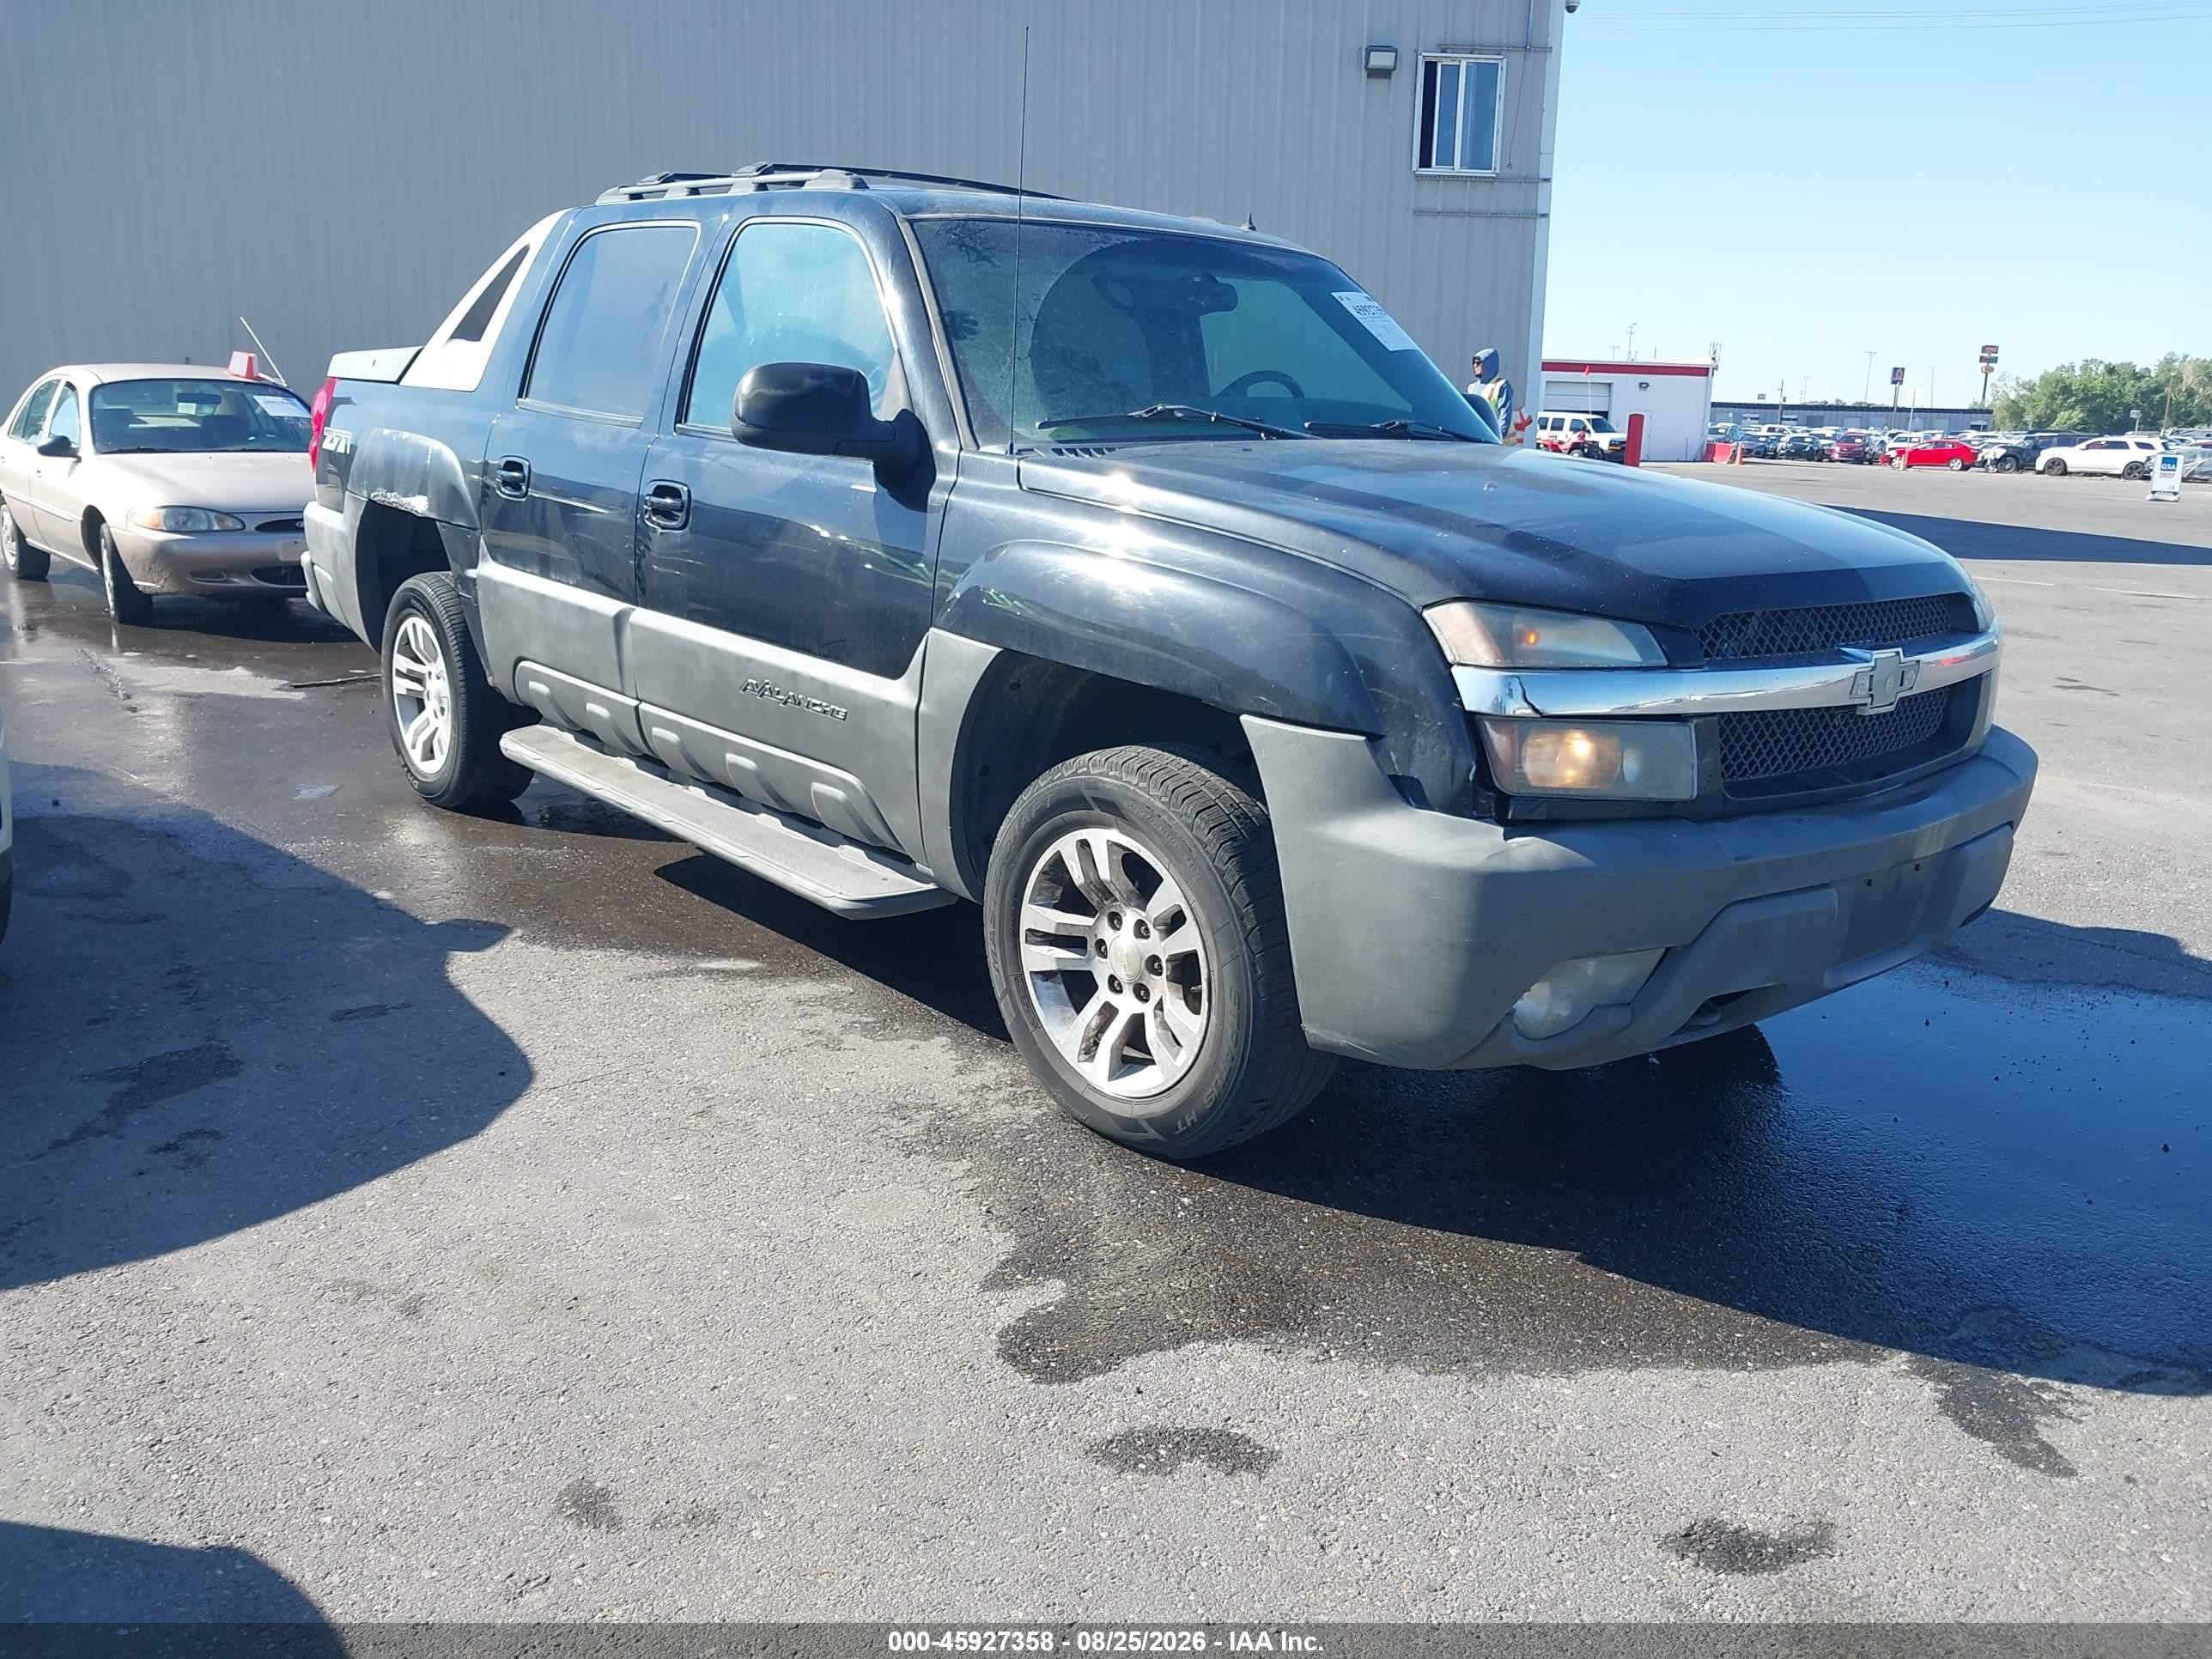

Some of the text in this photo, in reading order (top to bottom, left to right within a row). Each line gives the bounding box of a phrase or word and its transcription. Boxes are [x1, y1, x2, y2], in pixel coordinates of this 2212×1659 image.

[739, 678, 848, 721] AVALANCHE
[1174, 987, 1240, 1134] STRATUS HT
